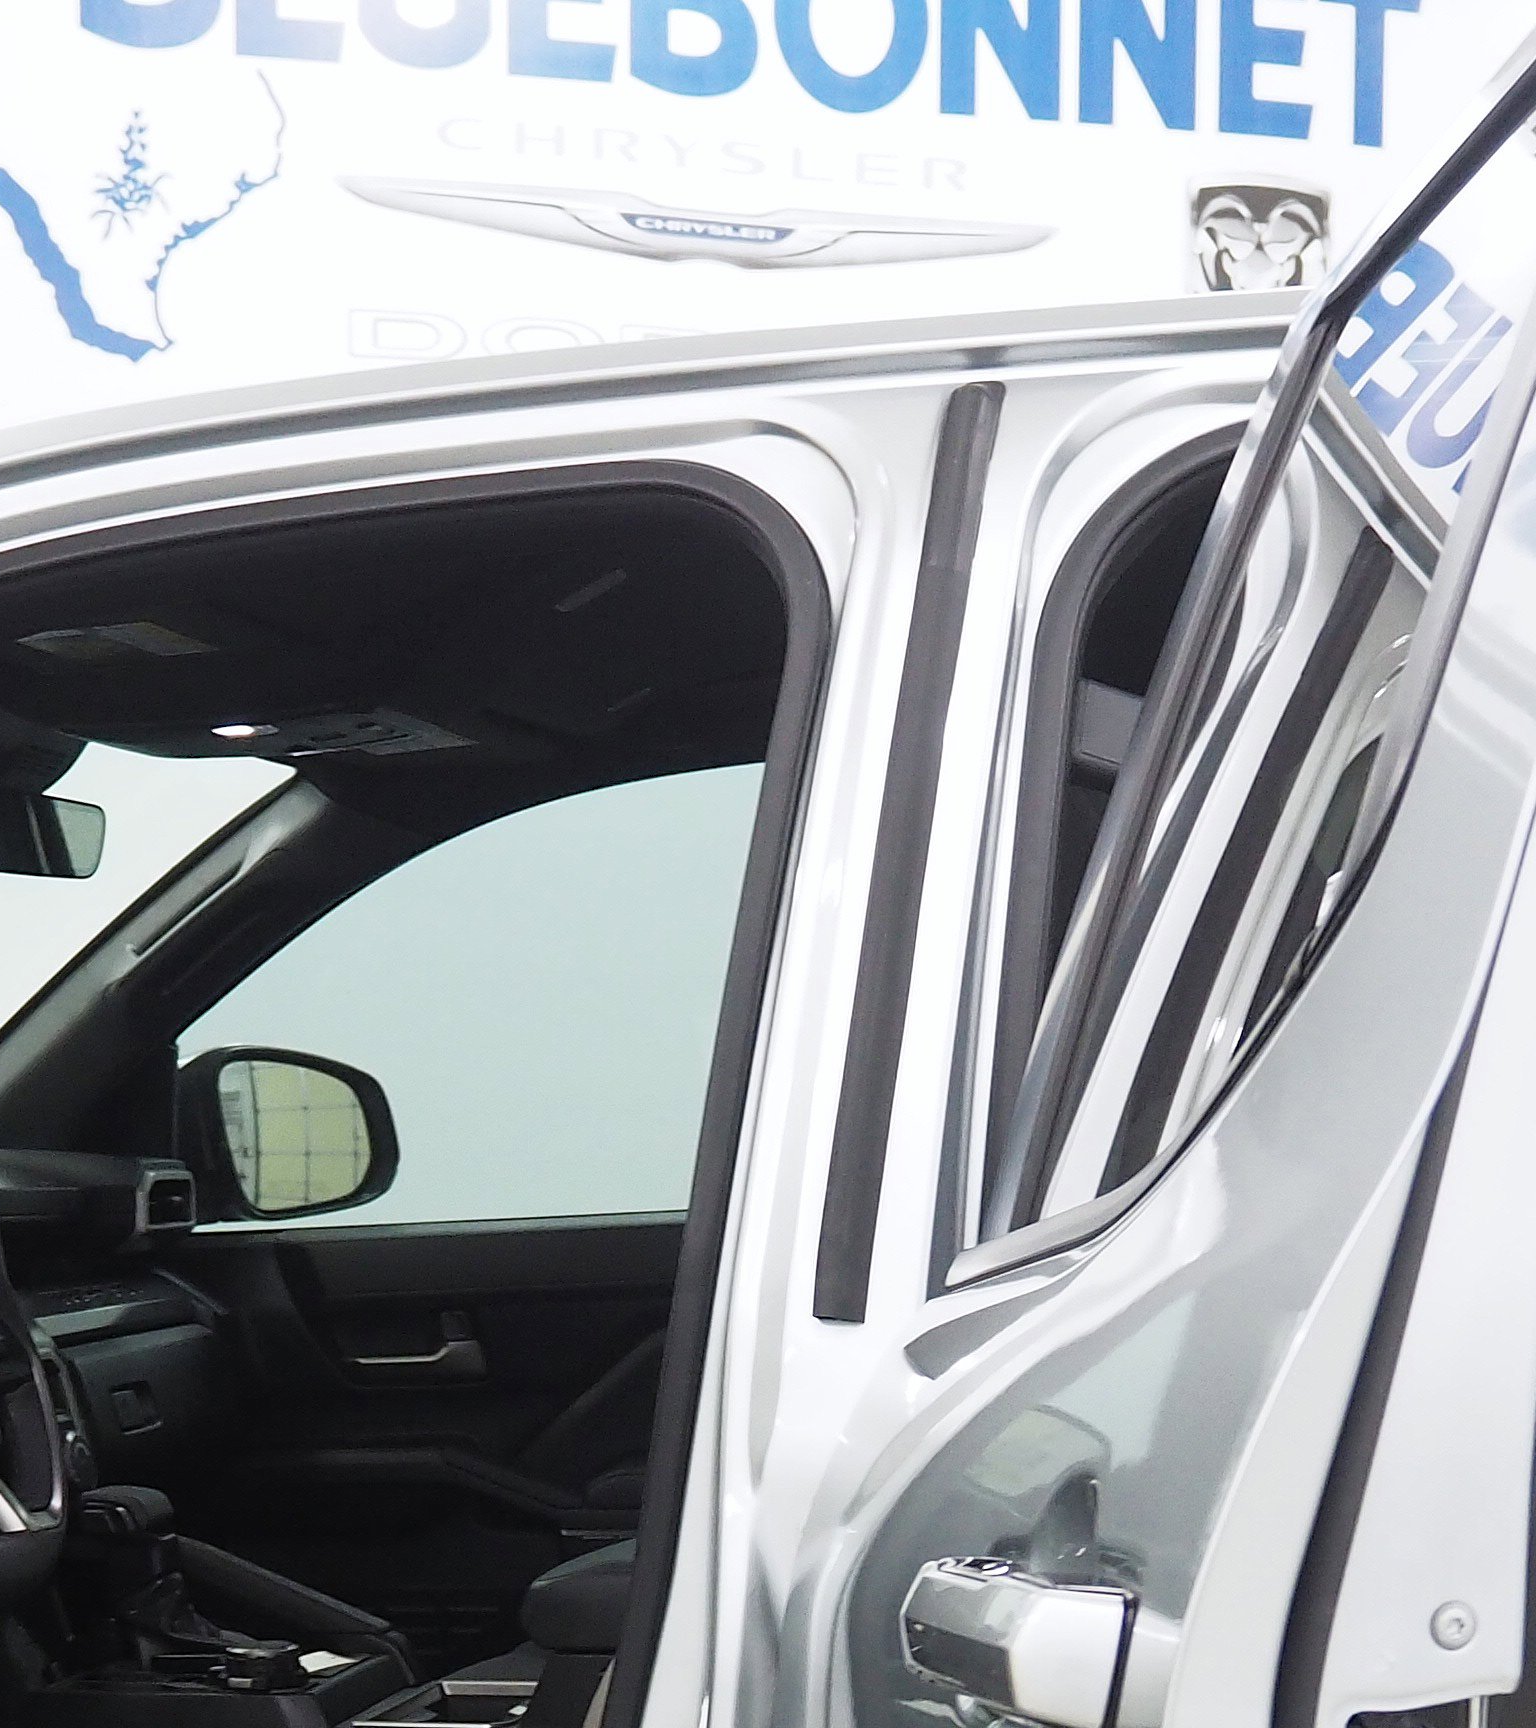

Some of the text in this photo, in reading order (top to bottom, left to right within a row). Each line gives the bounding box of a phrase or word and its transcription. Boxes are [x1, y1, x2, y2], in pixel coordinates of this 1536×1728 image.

[79, 0, 1421, 147] BONNET
[436, 117, 969, 192] CHRYSLER
[635, 216, 776, 242] CHRYSLER
